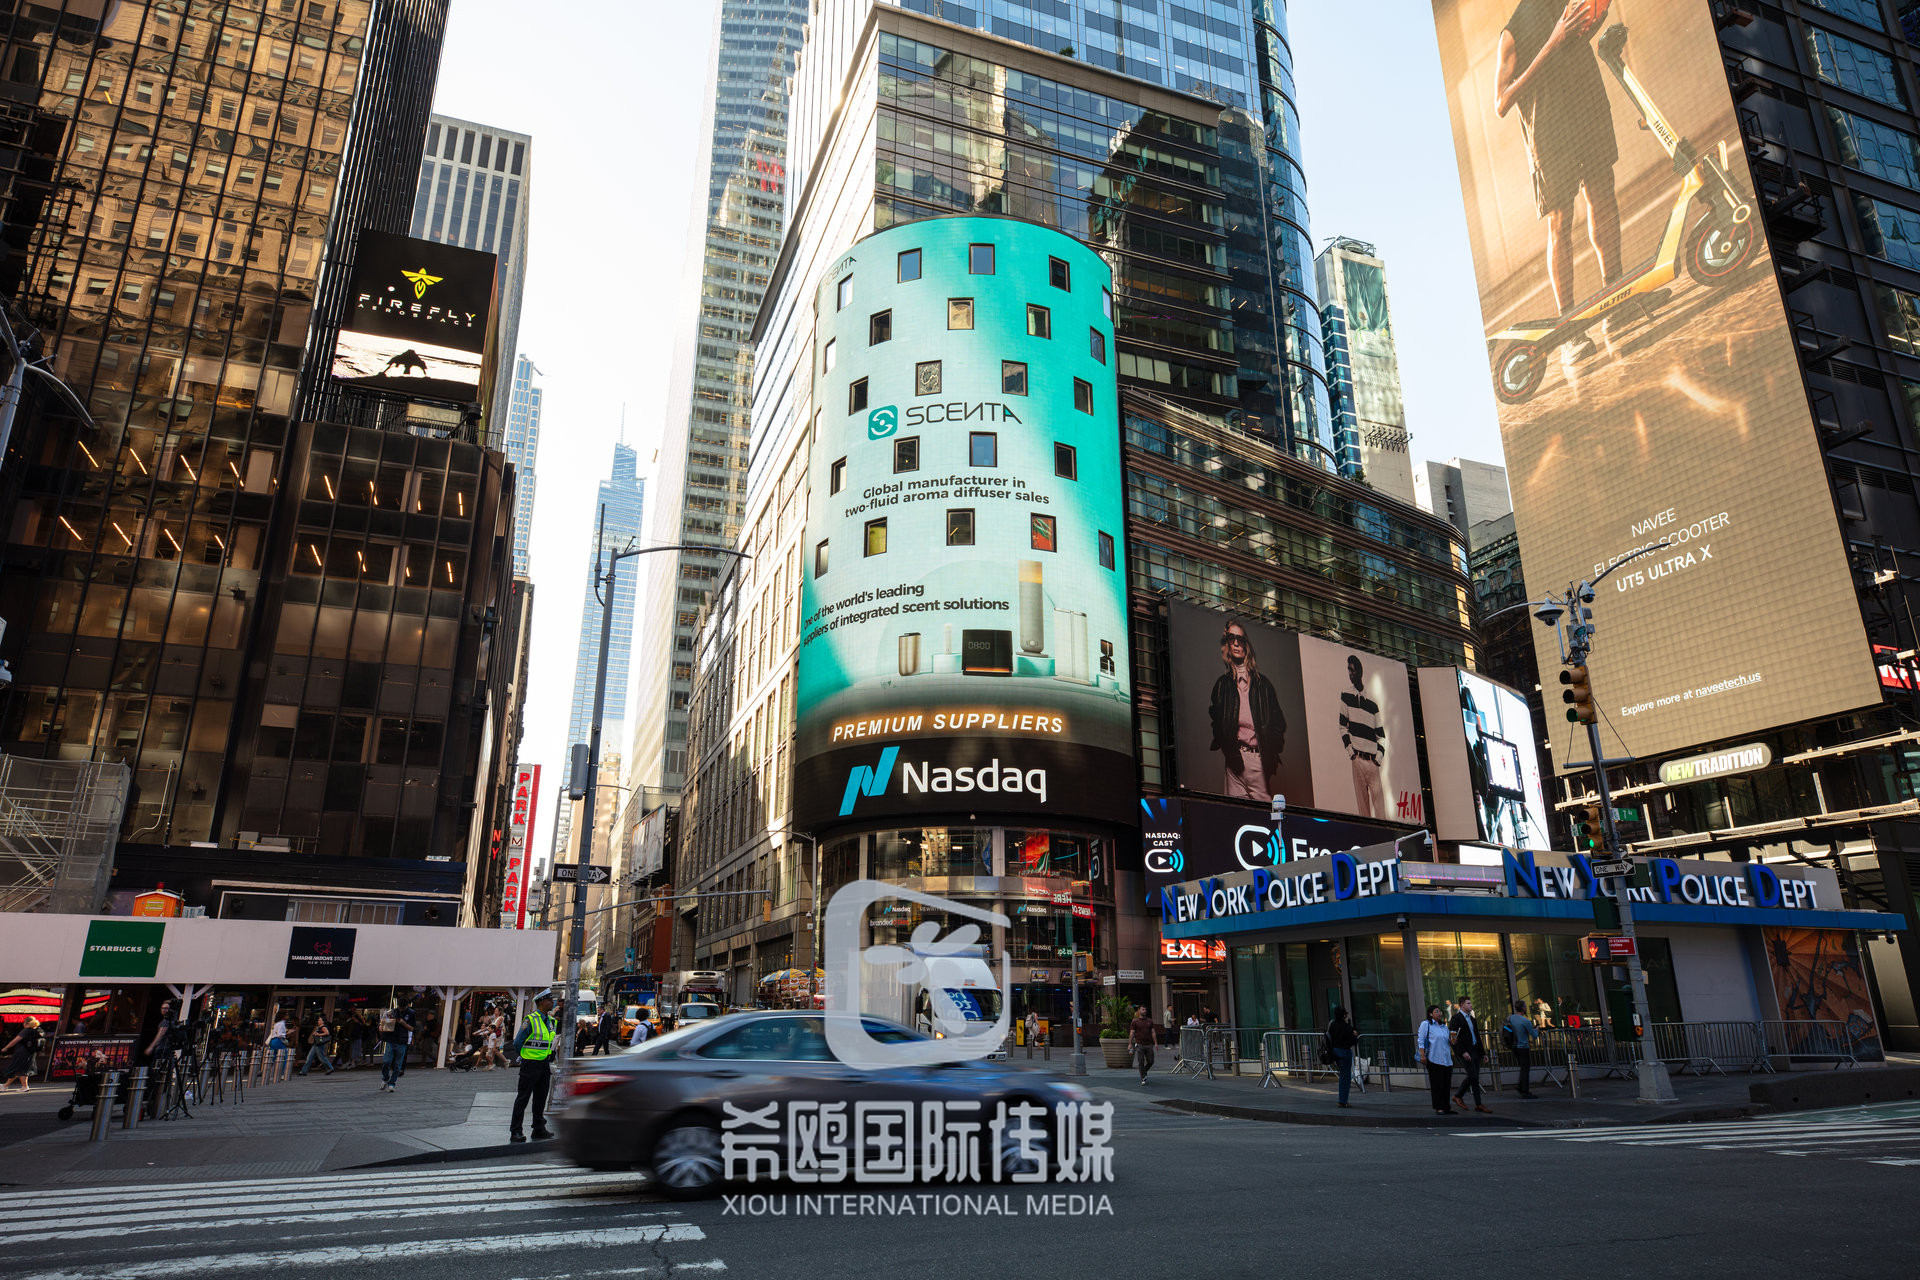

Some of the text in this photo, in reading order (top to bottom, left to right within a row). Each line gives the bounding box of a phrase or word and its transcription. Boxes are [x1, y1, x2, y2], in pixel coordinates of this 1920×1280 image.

[1653, 120, 1674, 148] NAVEE
[358, 303, 472, 328] AEROSPACE
[359, 293, 476, 321] FIREFLY
[906, 402, 1023, 427] SCENTA
[845, 486, 1050, 518] two-fluid aroma diffuser sales
[863, 475, 1026, 499] Global manufacturer in
[1631, 507, 1676, 537] NAVEE
[1660, 511, 1730, 557] SCOOTER
[1616, 544, 1713, 593] UT5 ULTRA X
[813, 608, 822, 622] of
[821, 604, 834, 617] the
[836, 591, 874, 611] world's
[876, 583, 925, 600] leading
[803, 598, 1010, 647] suppliers of integrated scent solutions
[1621, 671, 1762, 716] Explore more at naveetech.us
[832, 712, 1063, 742] PREMIUM SUPPLIERS
[1666, 747, 1764, 782] NEWTRADITION
[902, 758, 1047, 803] Nasdaq
[513, 772, 531, 825] PARK
[1397, 791, 1422, 822] H&M
[1145, 832, 1181, 840] NASDAQ:
[503, 857, 521, 912] PARK
[561, 869, 578, 877] ONE
[1502, 848, 1576, 899] NEW
[1655, 858, 1750, 907] POLICE
[1750, 864, 1820, 910] DEPT
[1595, 865, 1609, 874] ONE
[1160, 853, 1400, 924] NEW YORK POLICE DEPT
[892, 906, 911, 914] Nasdaq
[1026, 906, 1047, 914] Nasdaq
[89, 945, 142, 953] STARBUCKS
[1166, 943, 1202, 959] EXL
